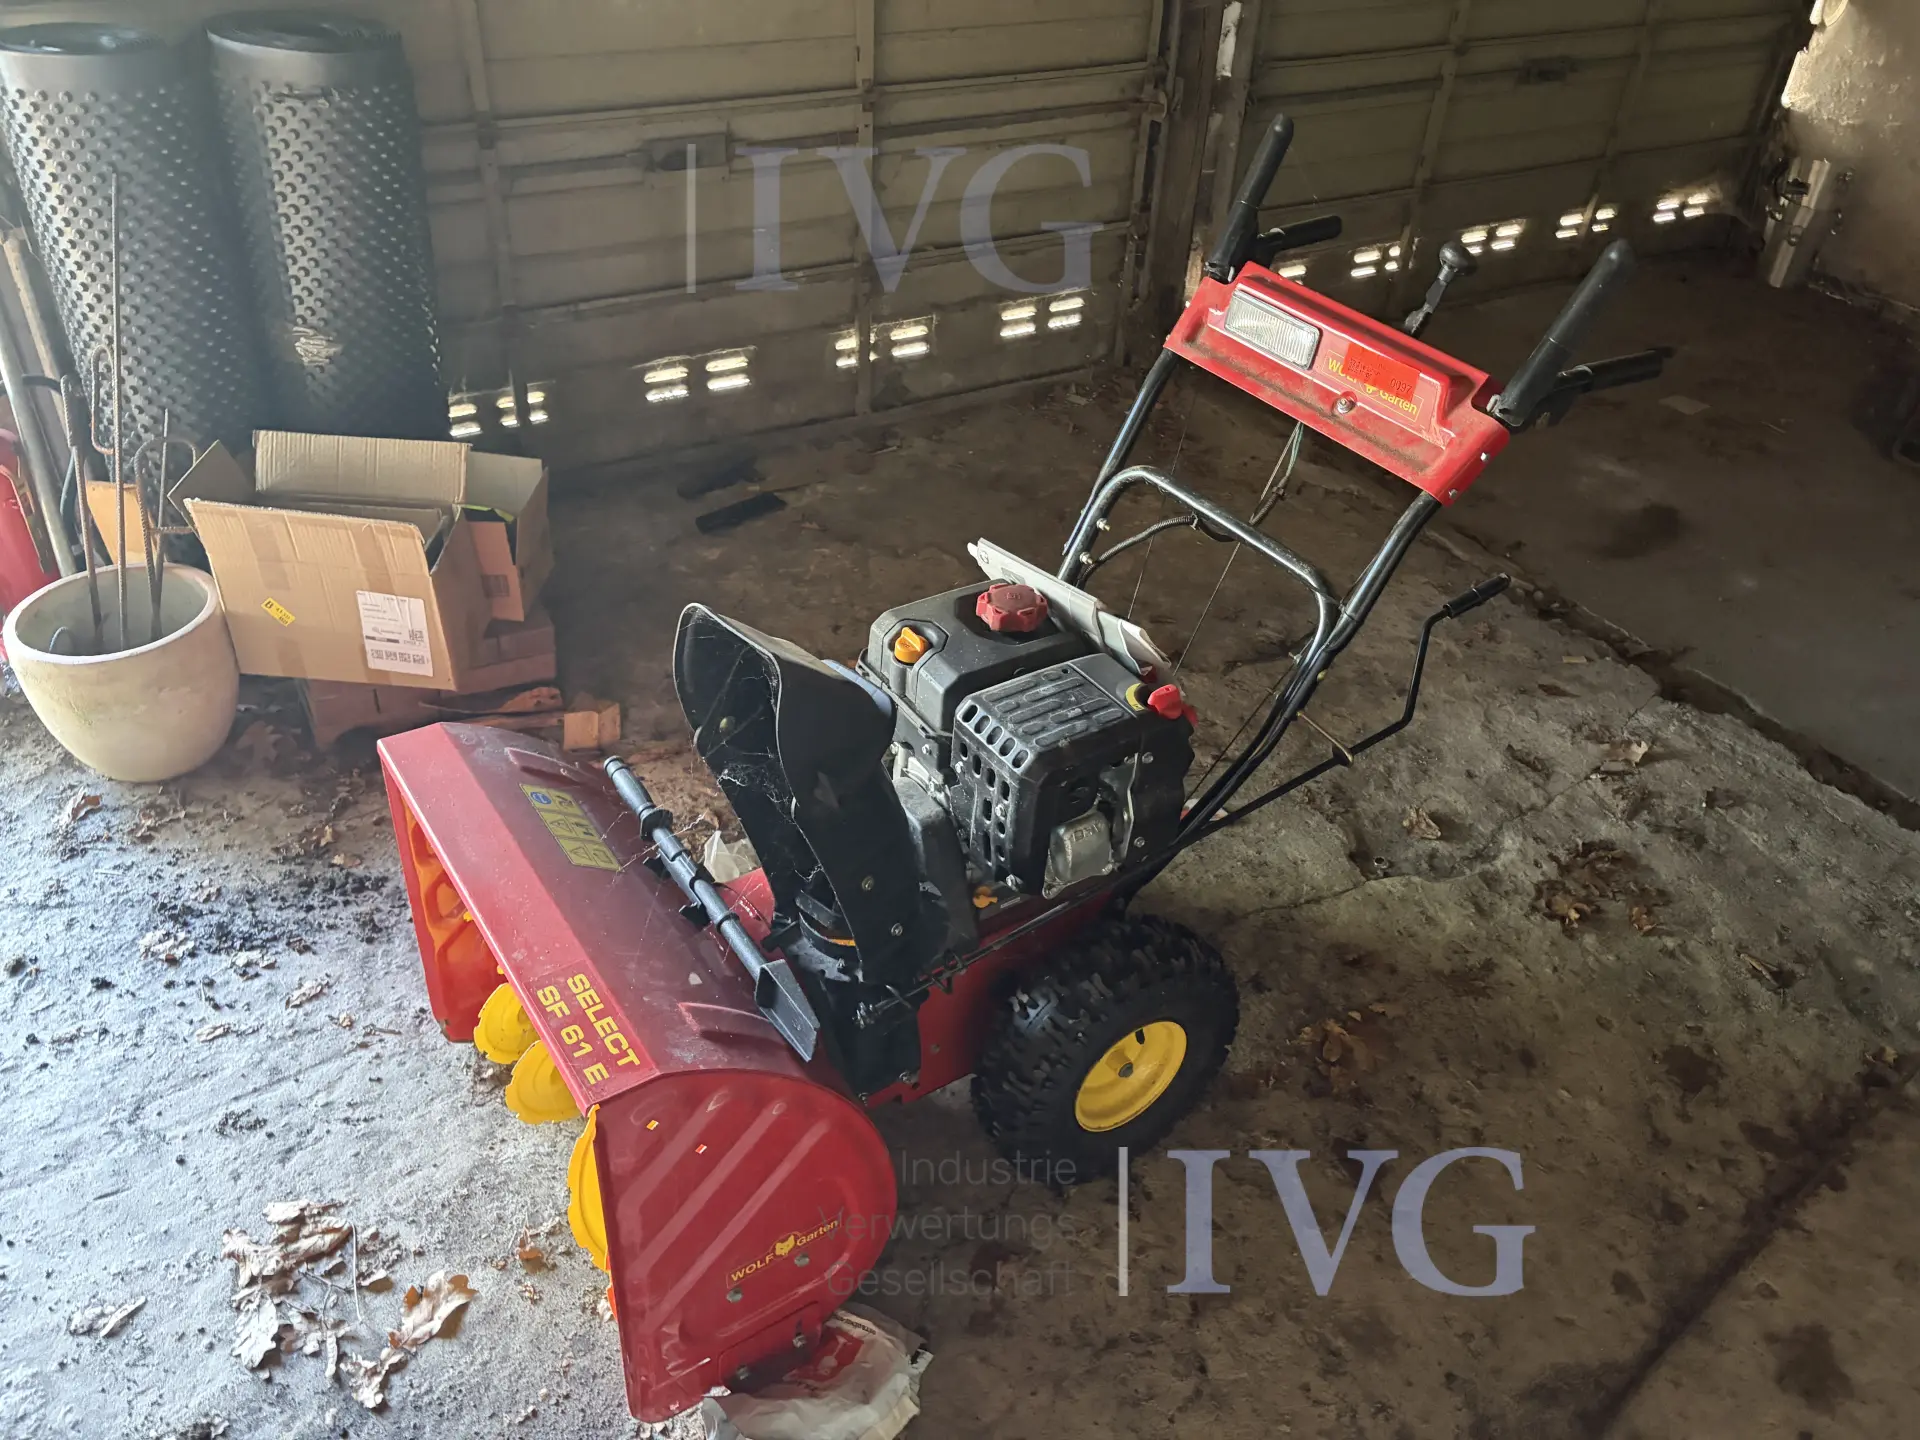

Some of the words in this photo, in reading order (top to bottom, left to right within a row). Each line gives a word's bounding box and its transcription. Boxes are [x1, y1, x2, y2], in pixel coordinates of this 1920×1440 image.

[536, 985, 571, 1018] SF
[560, 1024, 594, 1058] 61
[583, 1062, 610, 1085] E
[566, 973, 641, 1067] SELECT
[731, 1253, 774, 1281] WOLF
[796, 1220, 838, 1246] Garten
